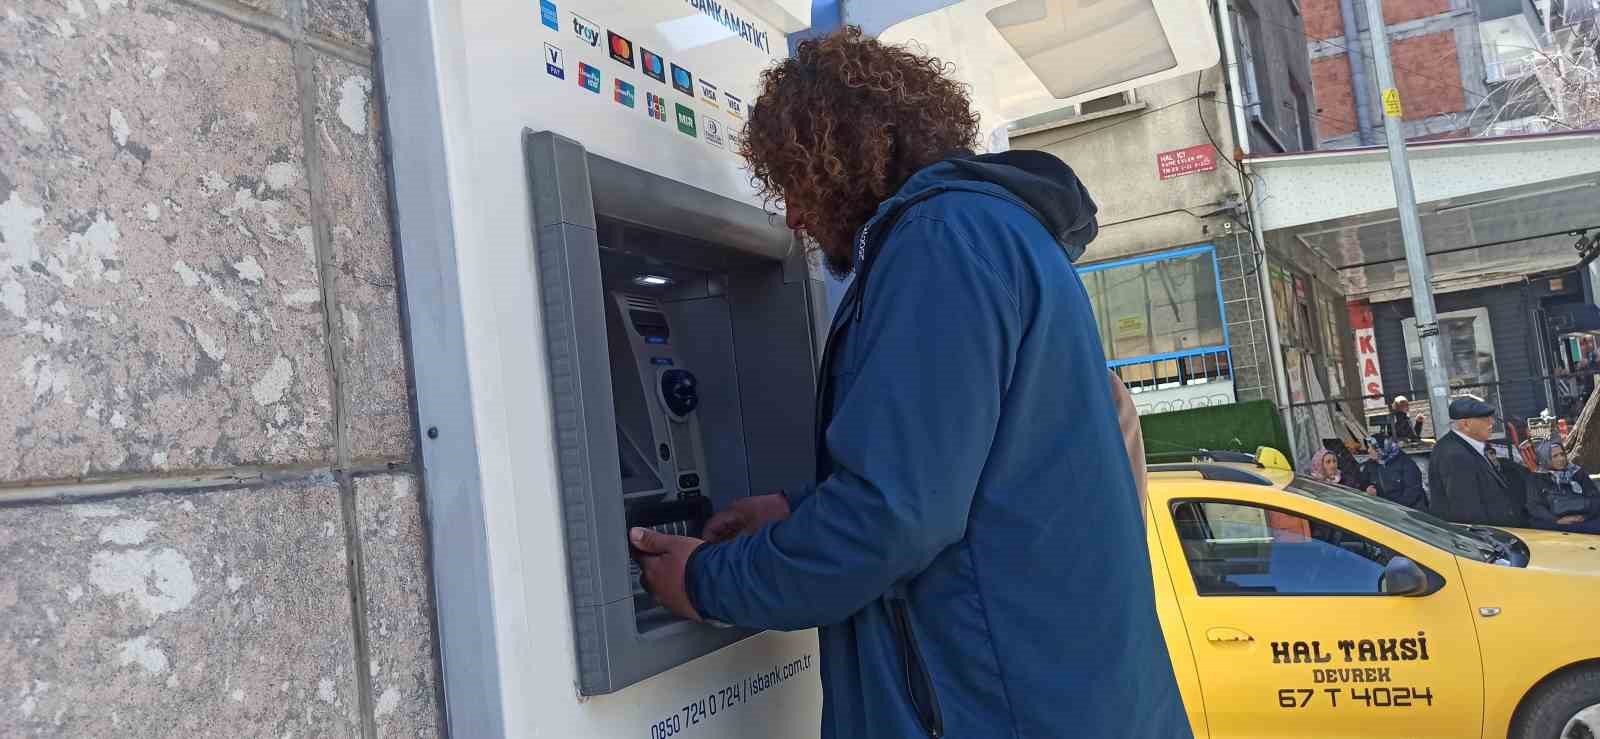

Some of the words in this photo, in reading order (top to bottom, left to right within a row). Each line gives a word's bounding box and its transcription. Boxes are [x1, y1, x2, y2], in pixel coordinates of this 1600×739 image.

[573, 17, 599, 47] troy
[549, 47, 558, 63] V
[702, 85, 717, 102] VISA
[728, 98, 741, 112] VISA
[679, 112, 693, 128] MIR
[1270, 640, 1331, 664] HAL
[1337, 630, 1429, 662] TAKSİ
[1312, 667, 1392, 684] DEVREK
[651, 714, 681, 739] 0850
[682, 699, 706, 729] 724
[708, 694, 716, 715] 0
[718, 681, 741, 710] 724
[749, 654, 811, 697] isbank.com.tr
[1278, 688, 1314, 708] 67
[1324, 688, 1341, 707] T
[1351, 686, 1433, 707] 4024
